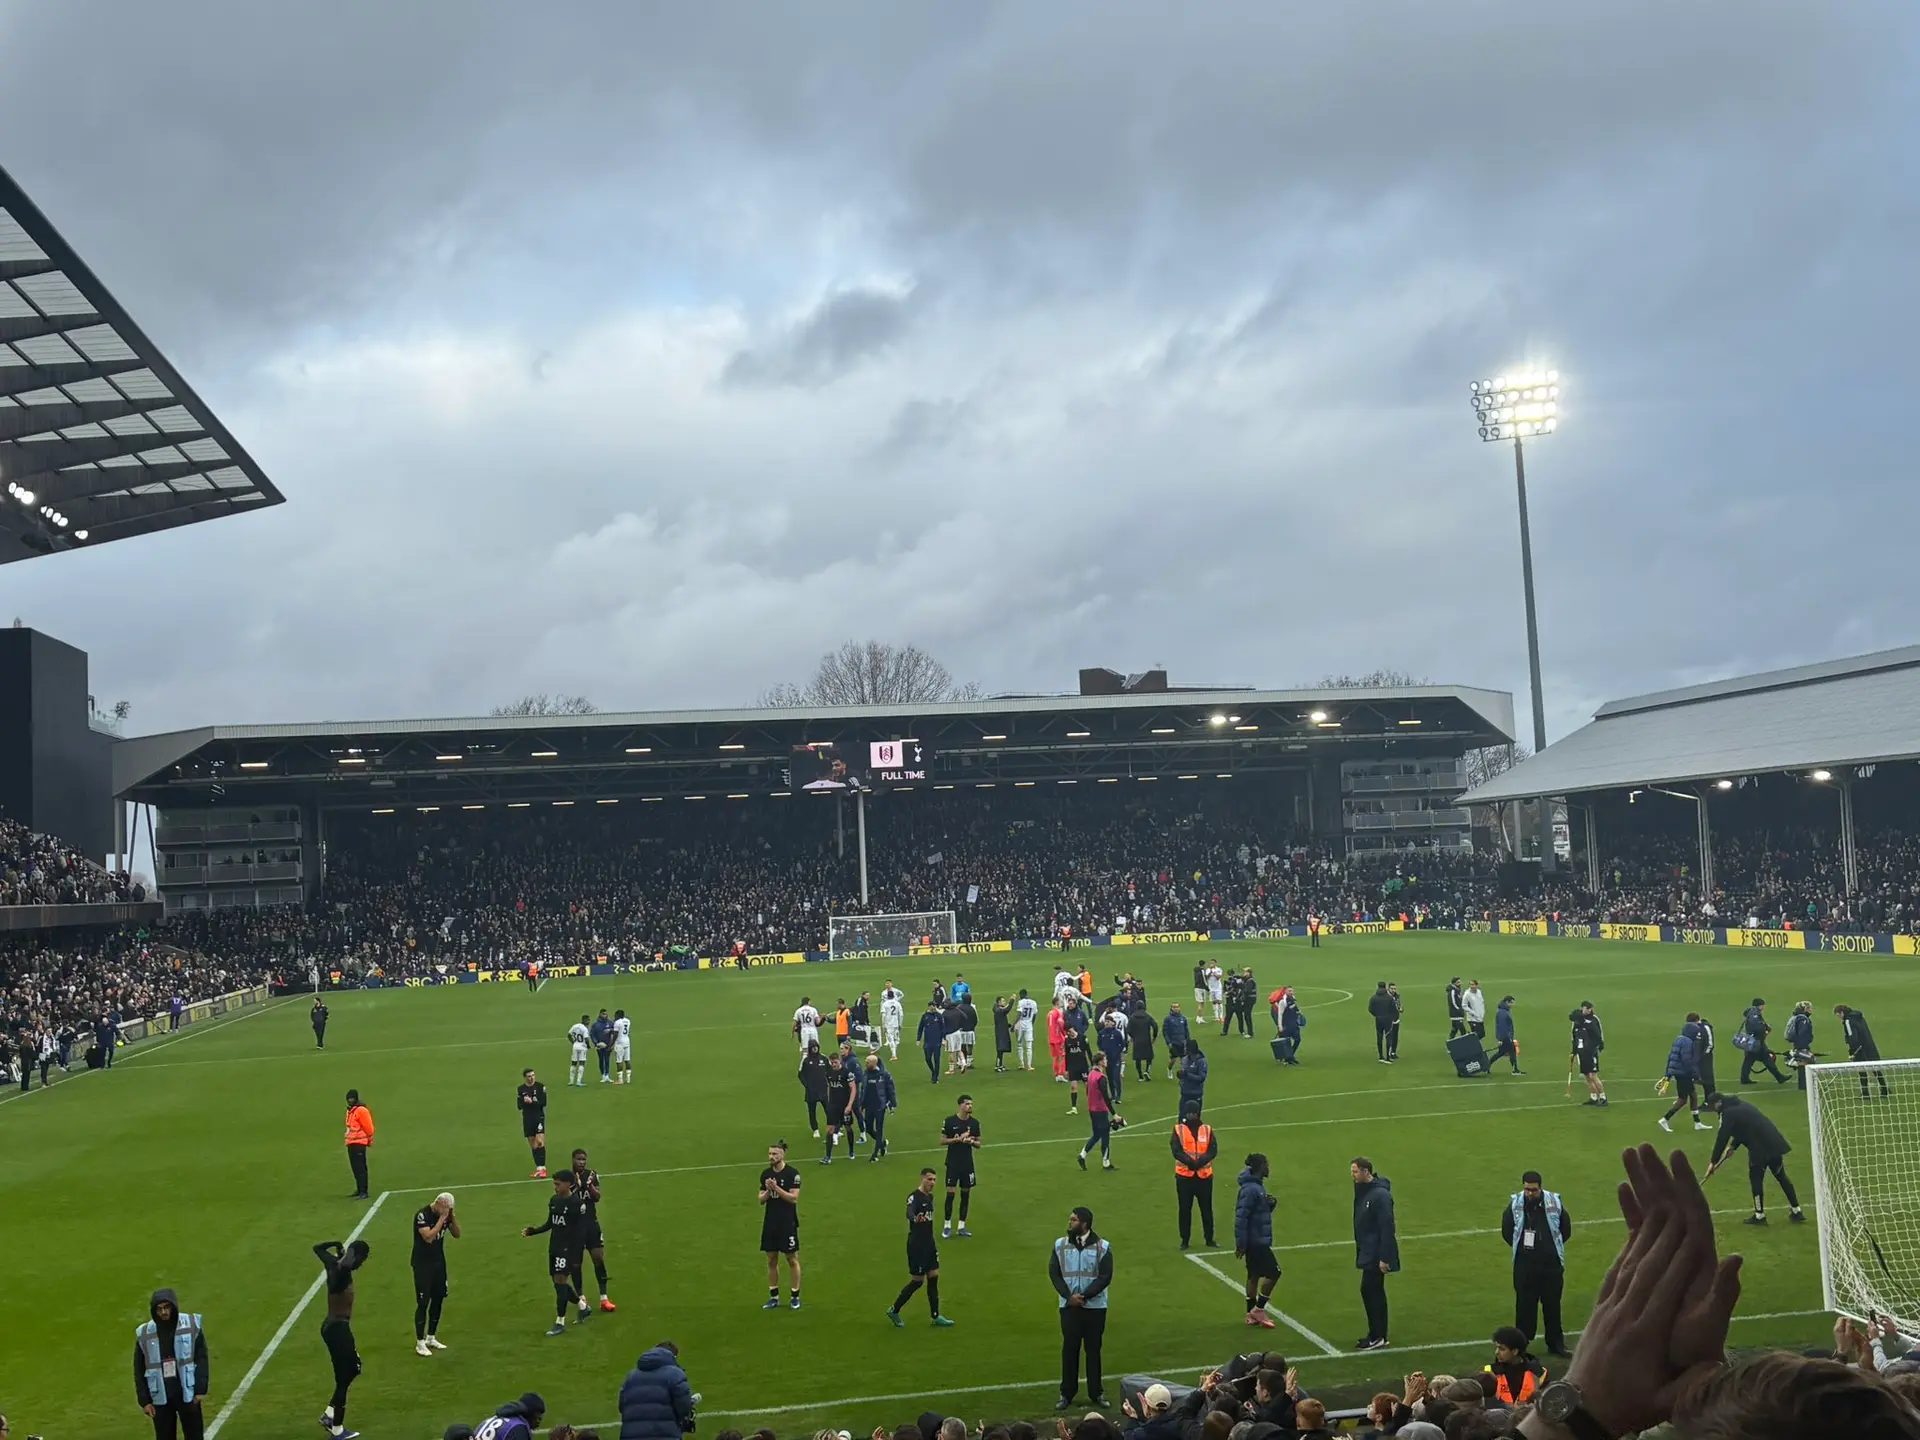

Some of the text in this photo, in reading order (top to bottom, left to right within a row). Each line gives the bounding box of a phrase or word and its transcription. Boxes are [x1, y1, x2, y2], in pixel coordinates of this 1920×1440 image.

[881, 770, 925, 780] FULL TIME
[1470, 920, 1491, 932] SBOTOP
[1514, 921, 1538, 935] SBOTOP
[1564, 924, 1591, 938] SBOTOP
[1145, 933, 1191, 943] SBOTOP
[1619, 927, 1648, 941] SBOTOP
[1682, 928, 1716, 945] SBOTOP
[1751, 931, 1788, 948] SBOTOP
[1832, 935, 1875, 953] SBOTOP
[842, 949, 891, 960] SBOTOP
[890, 1005, 896, 1016] 2
[1022, 1007, 1032, 1018] 31
[801, 1012, 812, 1024] 16
[622, 1024, 628, 1035] 3
[572, 1032, 584, 1043] 30
[789, 1236, 796, 1247] 3
[554, 1257, 566, 1269] 38
